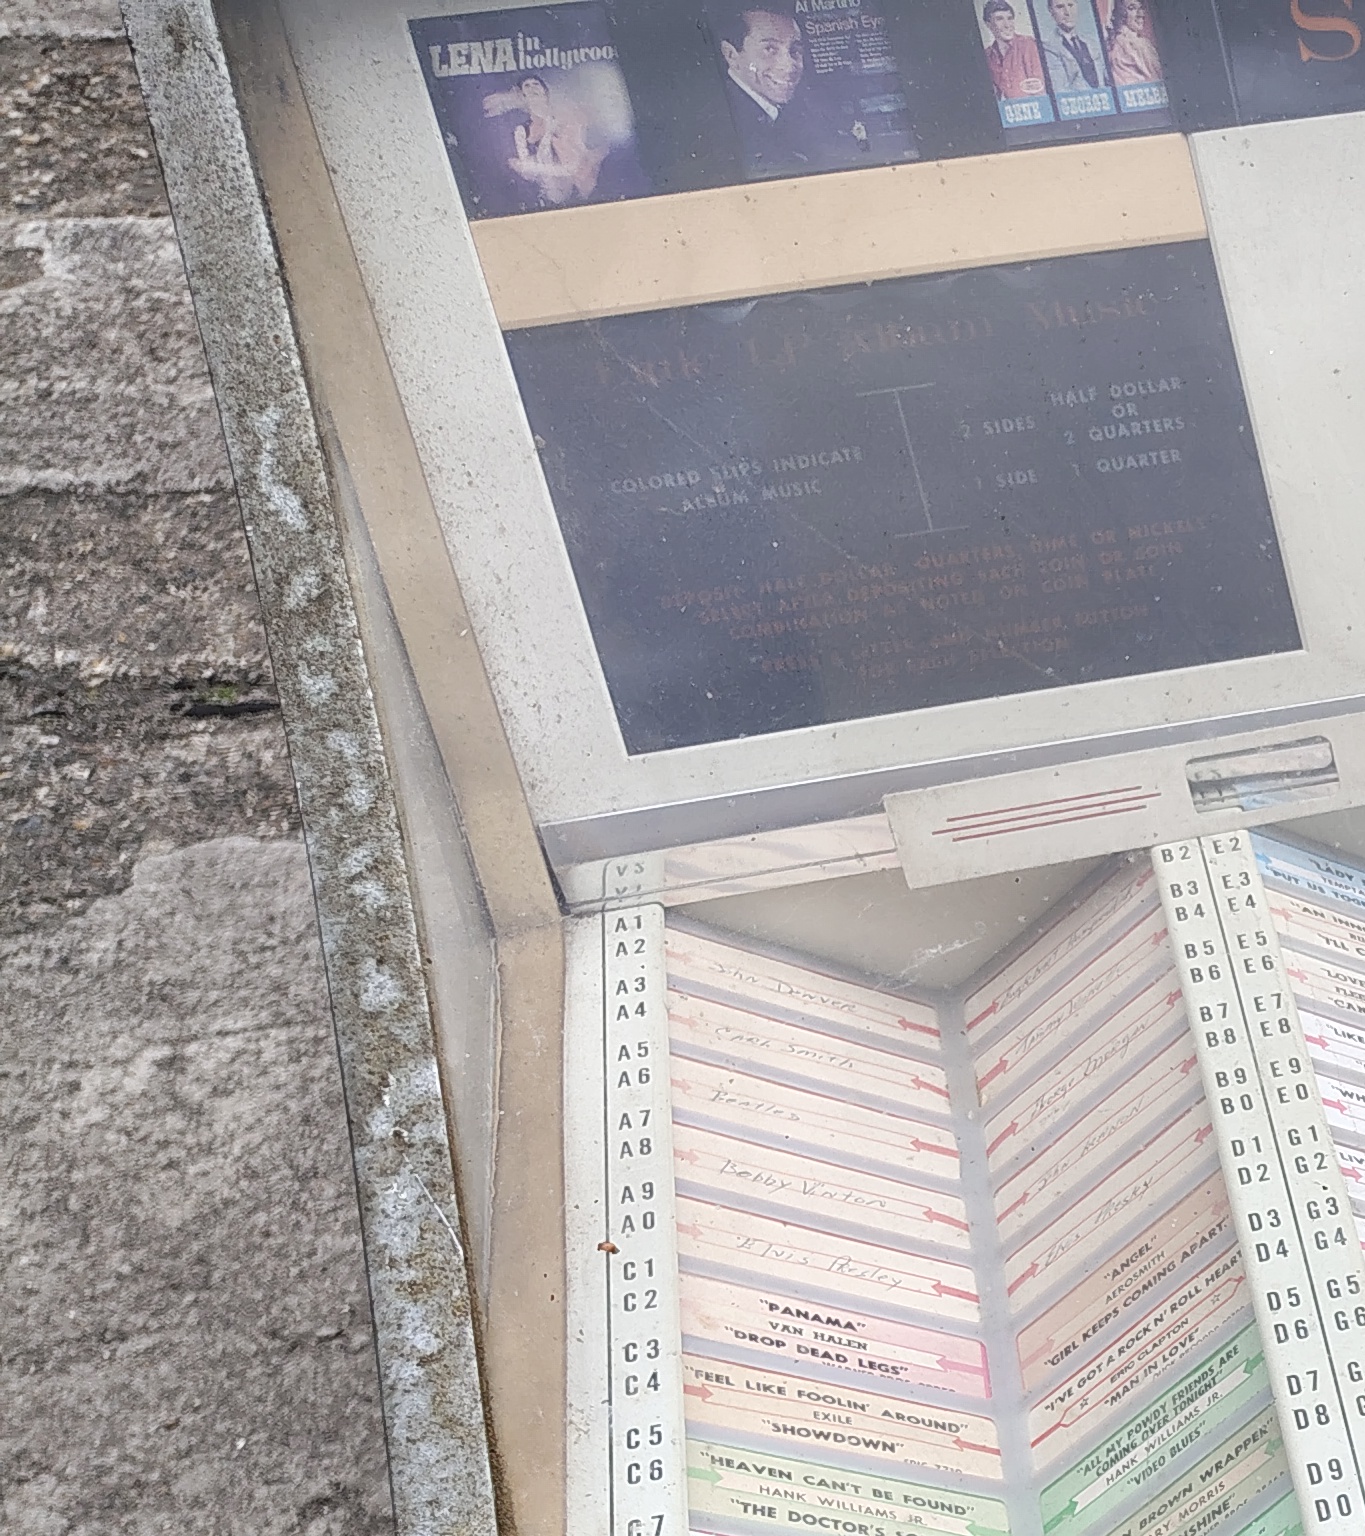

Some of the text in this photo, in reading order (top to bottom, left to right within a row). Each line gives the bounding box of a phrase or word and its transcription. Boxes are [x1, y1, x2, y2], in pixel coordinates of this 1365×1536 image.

[805, 18, 859, 35] Spanish
[428, 32, 540, 77] LENA in
[1048, 376, 1186, 408] HALF DOLLAR
[1111, 402, 1139, 420] OR
[982, 415, 1036, 437] SIDES
[1063, 416, 1187, 446] 2 QUARTERS
[610, 471, 704, 498] COLORED
[772, 445, 863, 475] INDICATE
[994, 469, 1038, 490] SIDE
[1095, 447, 1183, 475] QUARTER
[762, 478, 823, 503] MUSIC
[719, 1160, 791, 1194] Bobby
[1103, 1236, 1157, 1282] "ANGEL"
[1105, 1251, 1165, 1304] AEROSMITH
[759, 1299, 866, 1332] "PANAMA"
[1043, 1341, 1079, 1368] "GIRL
[1082, 1308, 1121, 1342] KEEPS
[1123, 1262, 1176, 1309] COMING
[724, 1325, 909, 1375] "DROP DEAD LEGS"
[769, 1321, 869, 1351] VAN HALEN
[1103, 1328, 1200, 1408] "MAN IN LOVE"
[684, 1365, 969, 1434] "FEEL LIKE FOOLIN' AROUND"
[813, 1410, 852, 1426] EXILE
[761, 1418, 904, 1454] "SHOWDOWN"
[1126, 1420, 1206, 1488] "VIDEO BLUES"
[700, 1451, 975, 1516] "HEAVEN CAN'T BE FOUND"
[1138, 1483, 1193, 1530] BROWN
[1199, 1418, 1273, 1483] WRAPPER"
[730, 1498, 778, 1519] "THE
[759, 1485, 928, 1526] HANK WILLIAMS JR.
[1178, 1481, 1226, 1523] MORRIS
